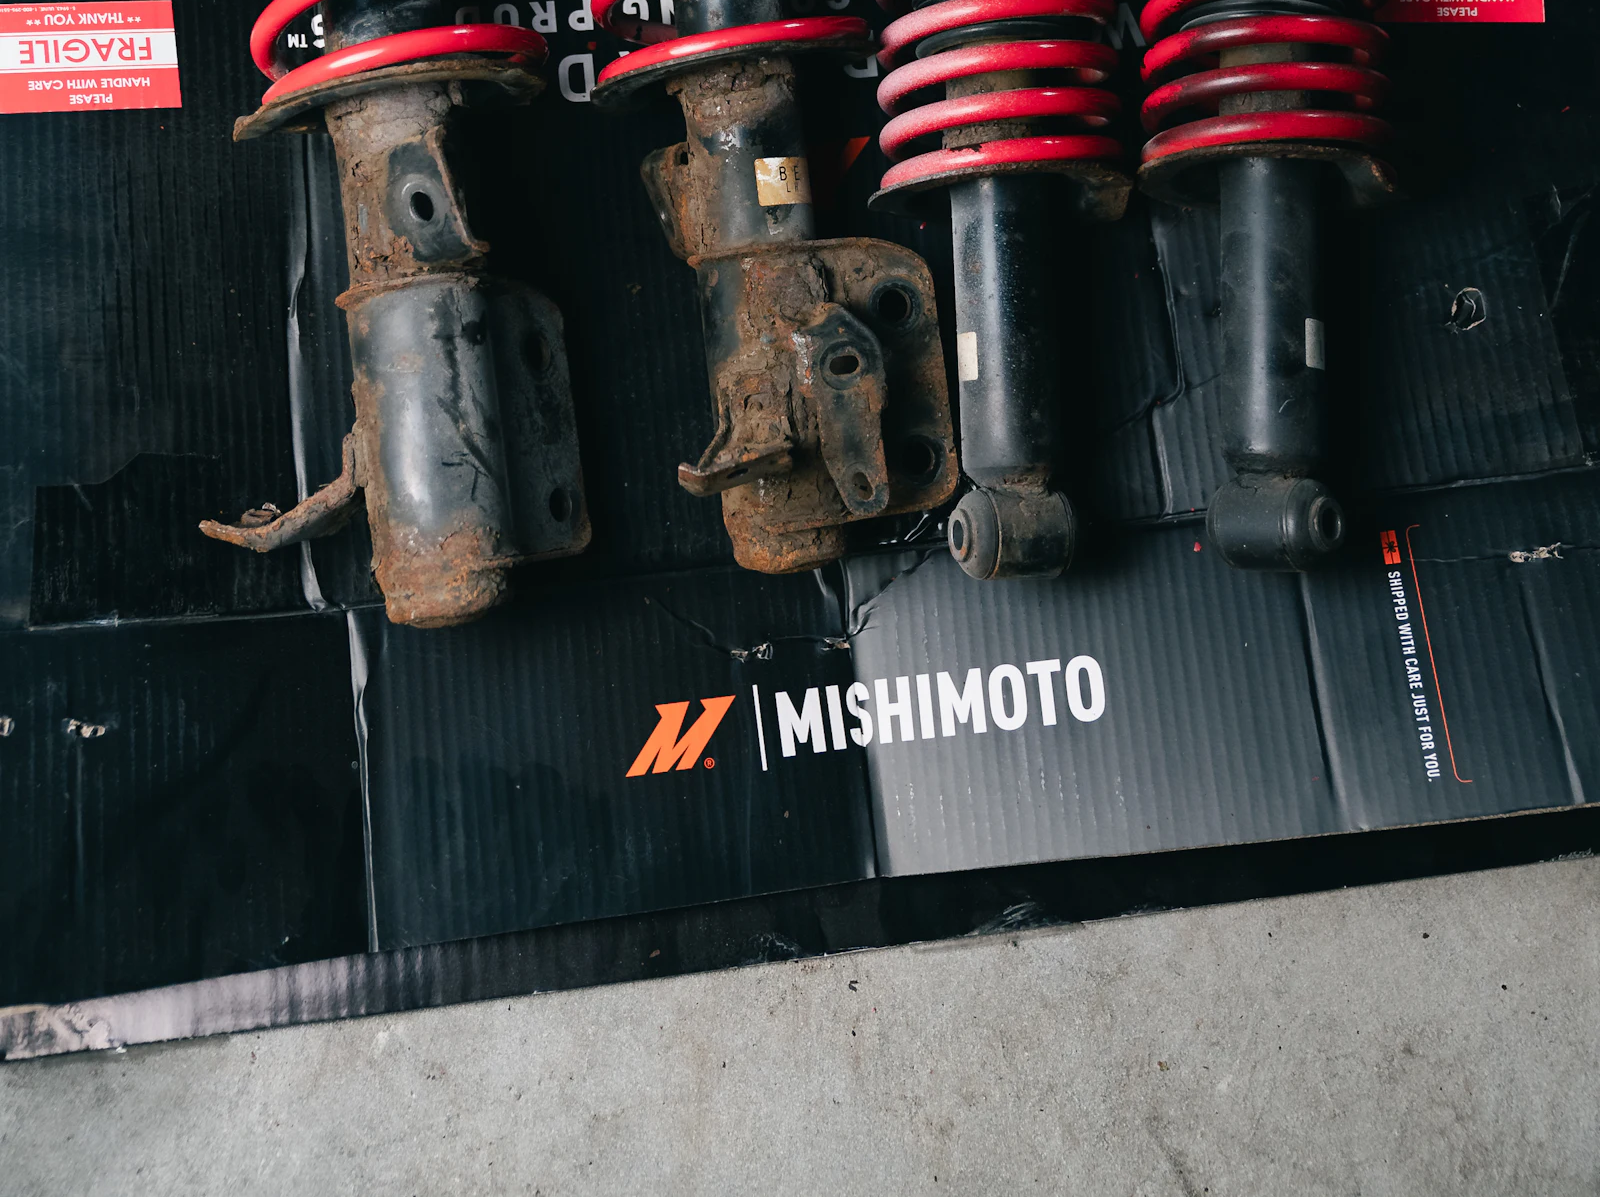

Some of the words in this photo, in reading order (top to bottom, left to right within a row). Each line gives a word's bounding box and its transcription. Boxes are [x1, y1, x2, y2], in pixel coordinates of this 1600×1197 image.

[44, 14, 75, 26] YOU
[78, 12, 124, 25] THANK
[1436, 6, 1478, 17] PLEASE
[18, 37, 153, 64] FRAGILE
[28, 80, 64, 91] CARE
[66, 78, 98, 89] WITH
[100, 77, 151, 89] HANDLE
[69, 93, 113, 105] PLEASE
[1387, 570, 1411, 621] SHIPPED
[1397, 622, 1417, 655] WITH
[1404, 657, 1424, 690] CARE
[774, 654, 1106, 759] MISHIMOTO
[1411, 691, 1430, 722] JUST
[1417, 725, 1435, 751] FOR
[1423, 752, 1442, 783] YOU.
